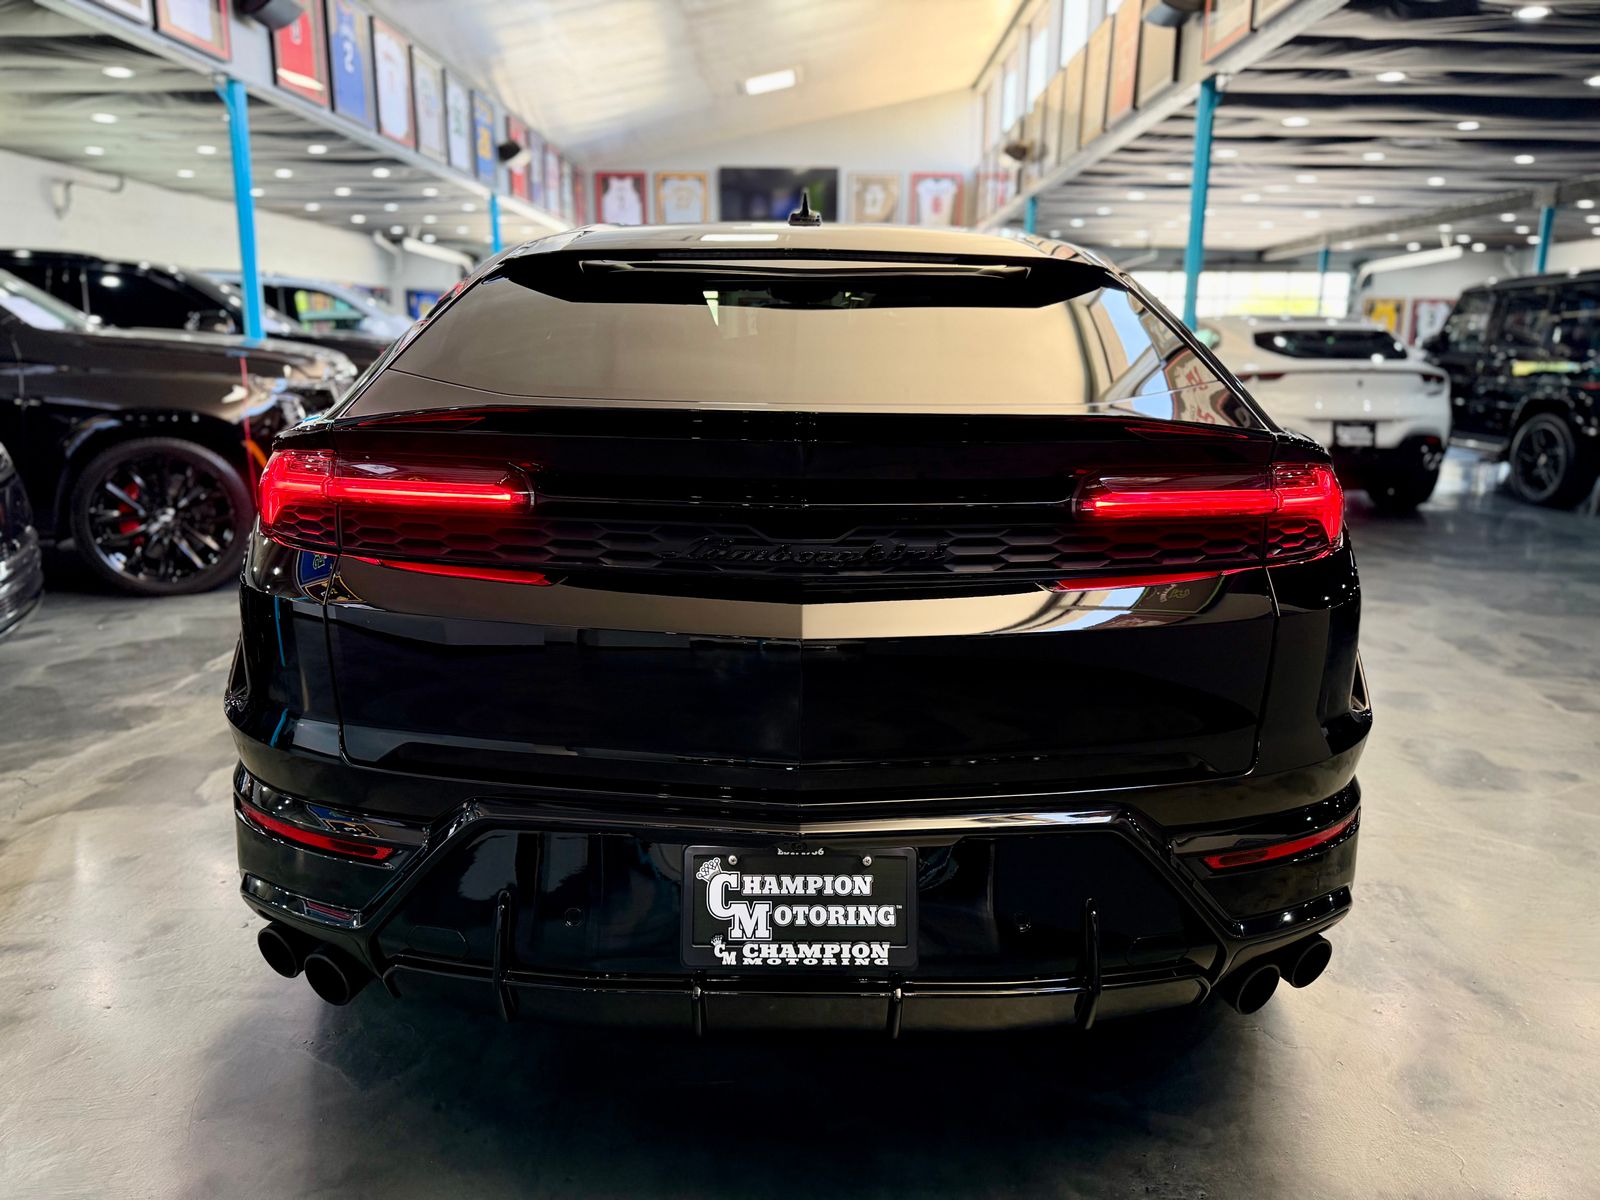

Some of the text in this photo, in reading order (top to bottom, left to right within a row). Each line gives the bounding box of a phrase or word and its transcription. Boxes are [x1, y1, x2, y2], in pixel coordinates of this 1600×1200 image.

[706, 871, 873, 921] CHAMPION
[728, 900, 897, 941] MOTORING
[742, 943, 890, 958] CHAMPION
[742, 957, 889, 966] MOTORING
